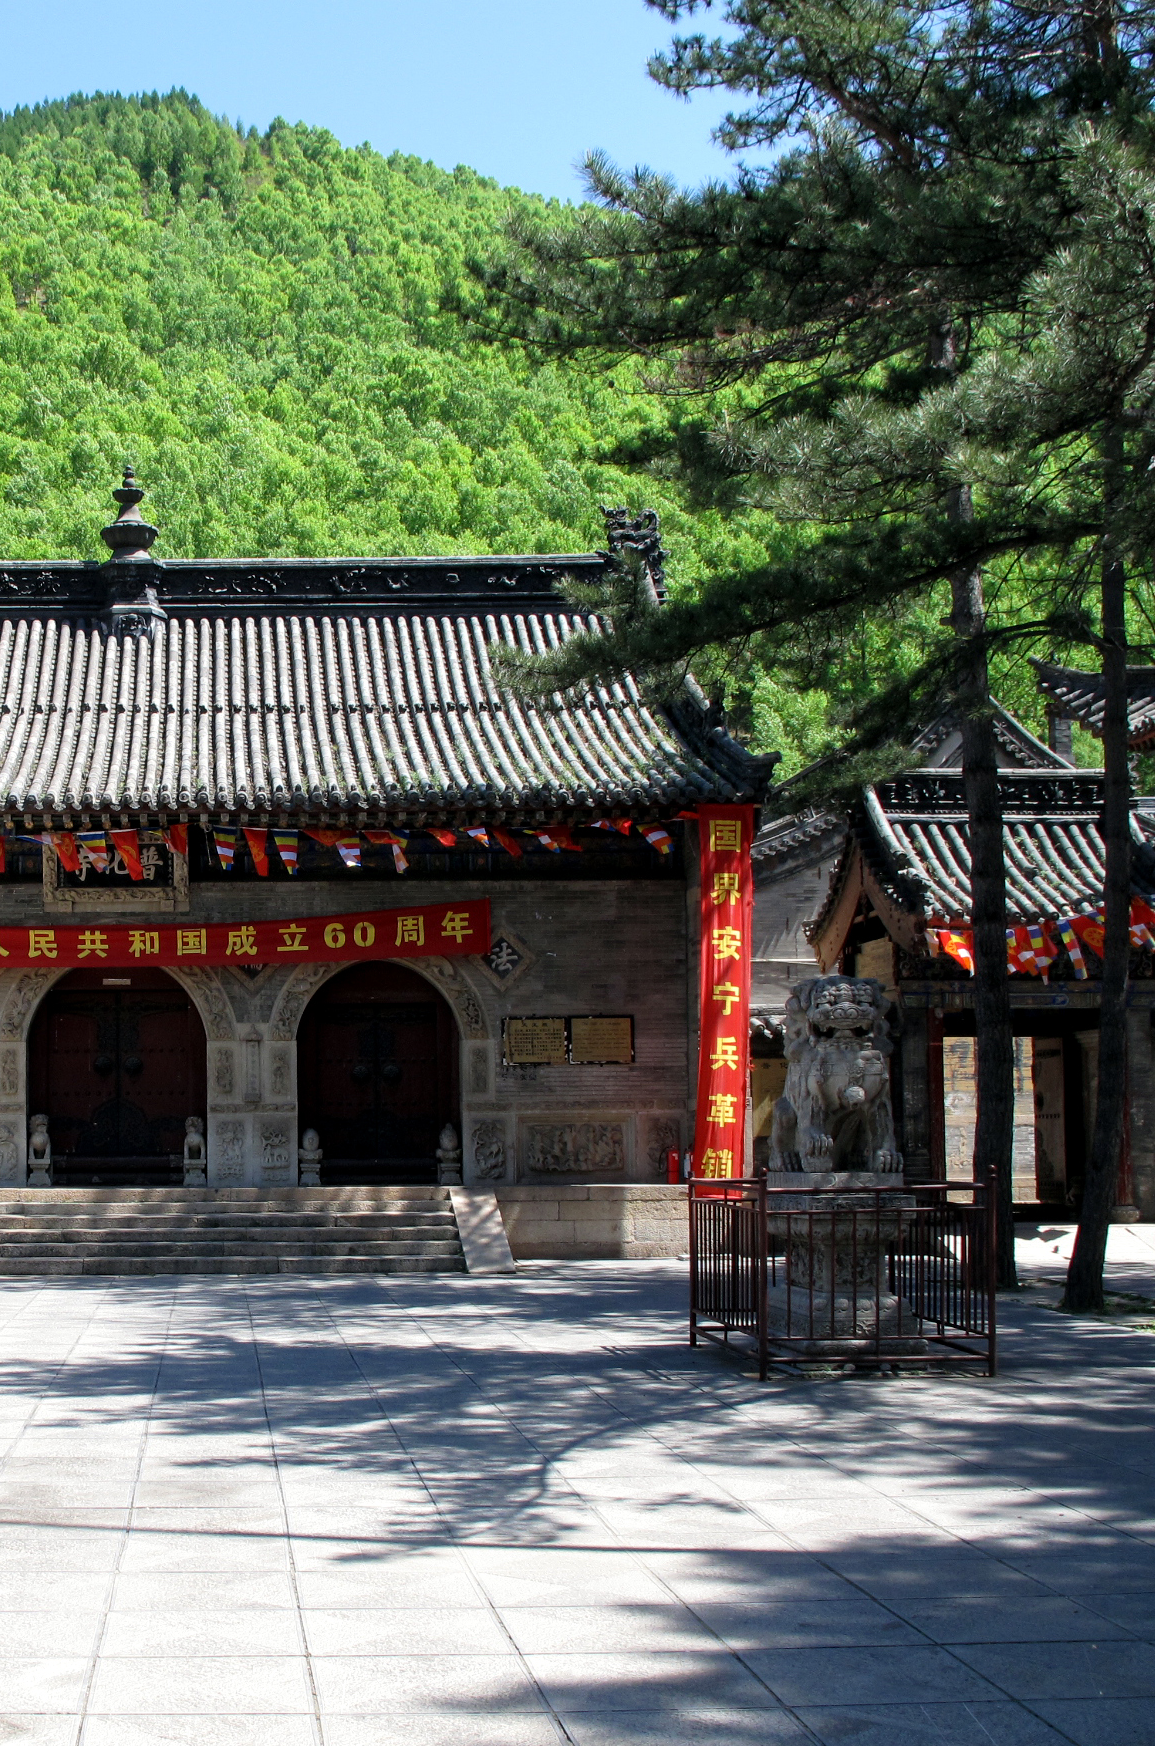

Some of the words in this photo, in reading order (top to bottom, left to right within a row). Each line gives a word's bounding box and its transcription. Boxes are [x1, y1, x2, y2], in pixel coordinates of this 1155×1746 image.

[490, 942, 518, 971] 法
[701, 820, 741, 1178] 国界安宁兵革销
